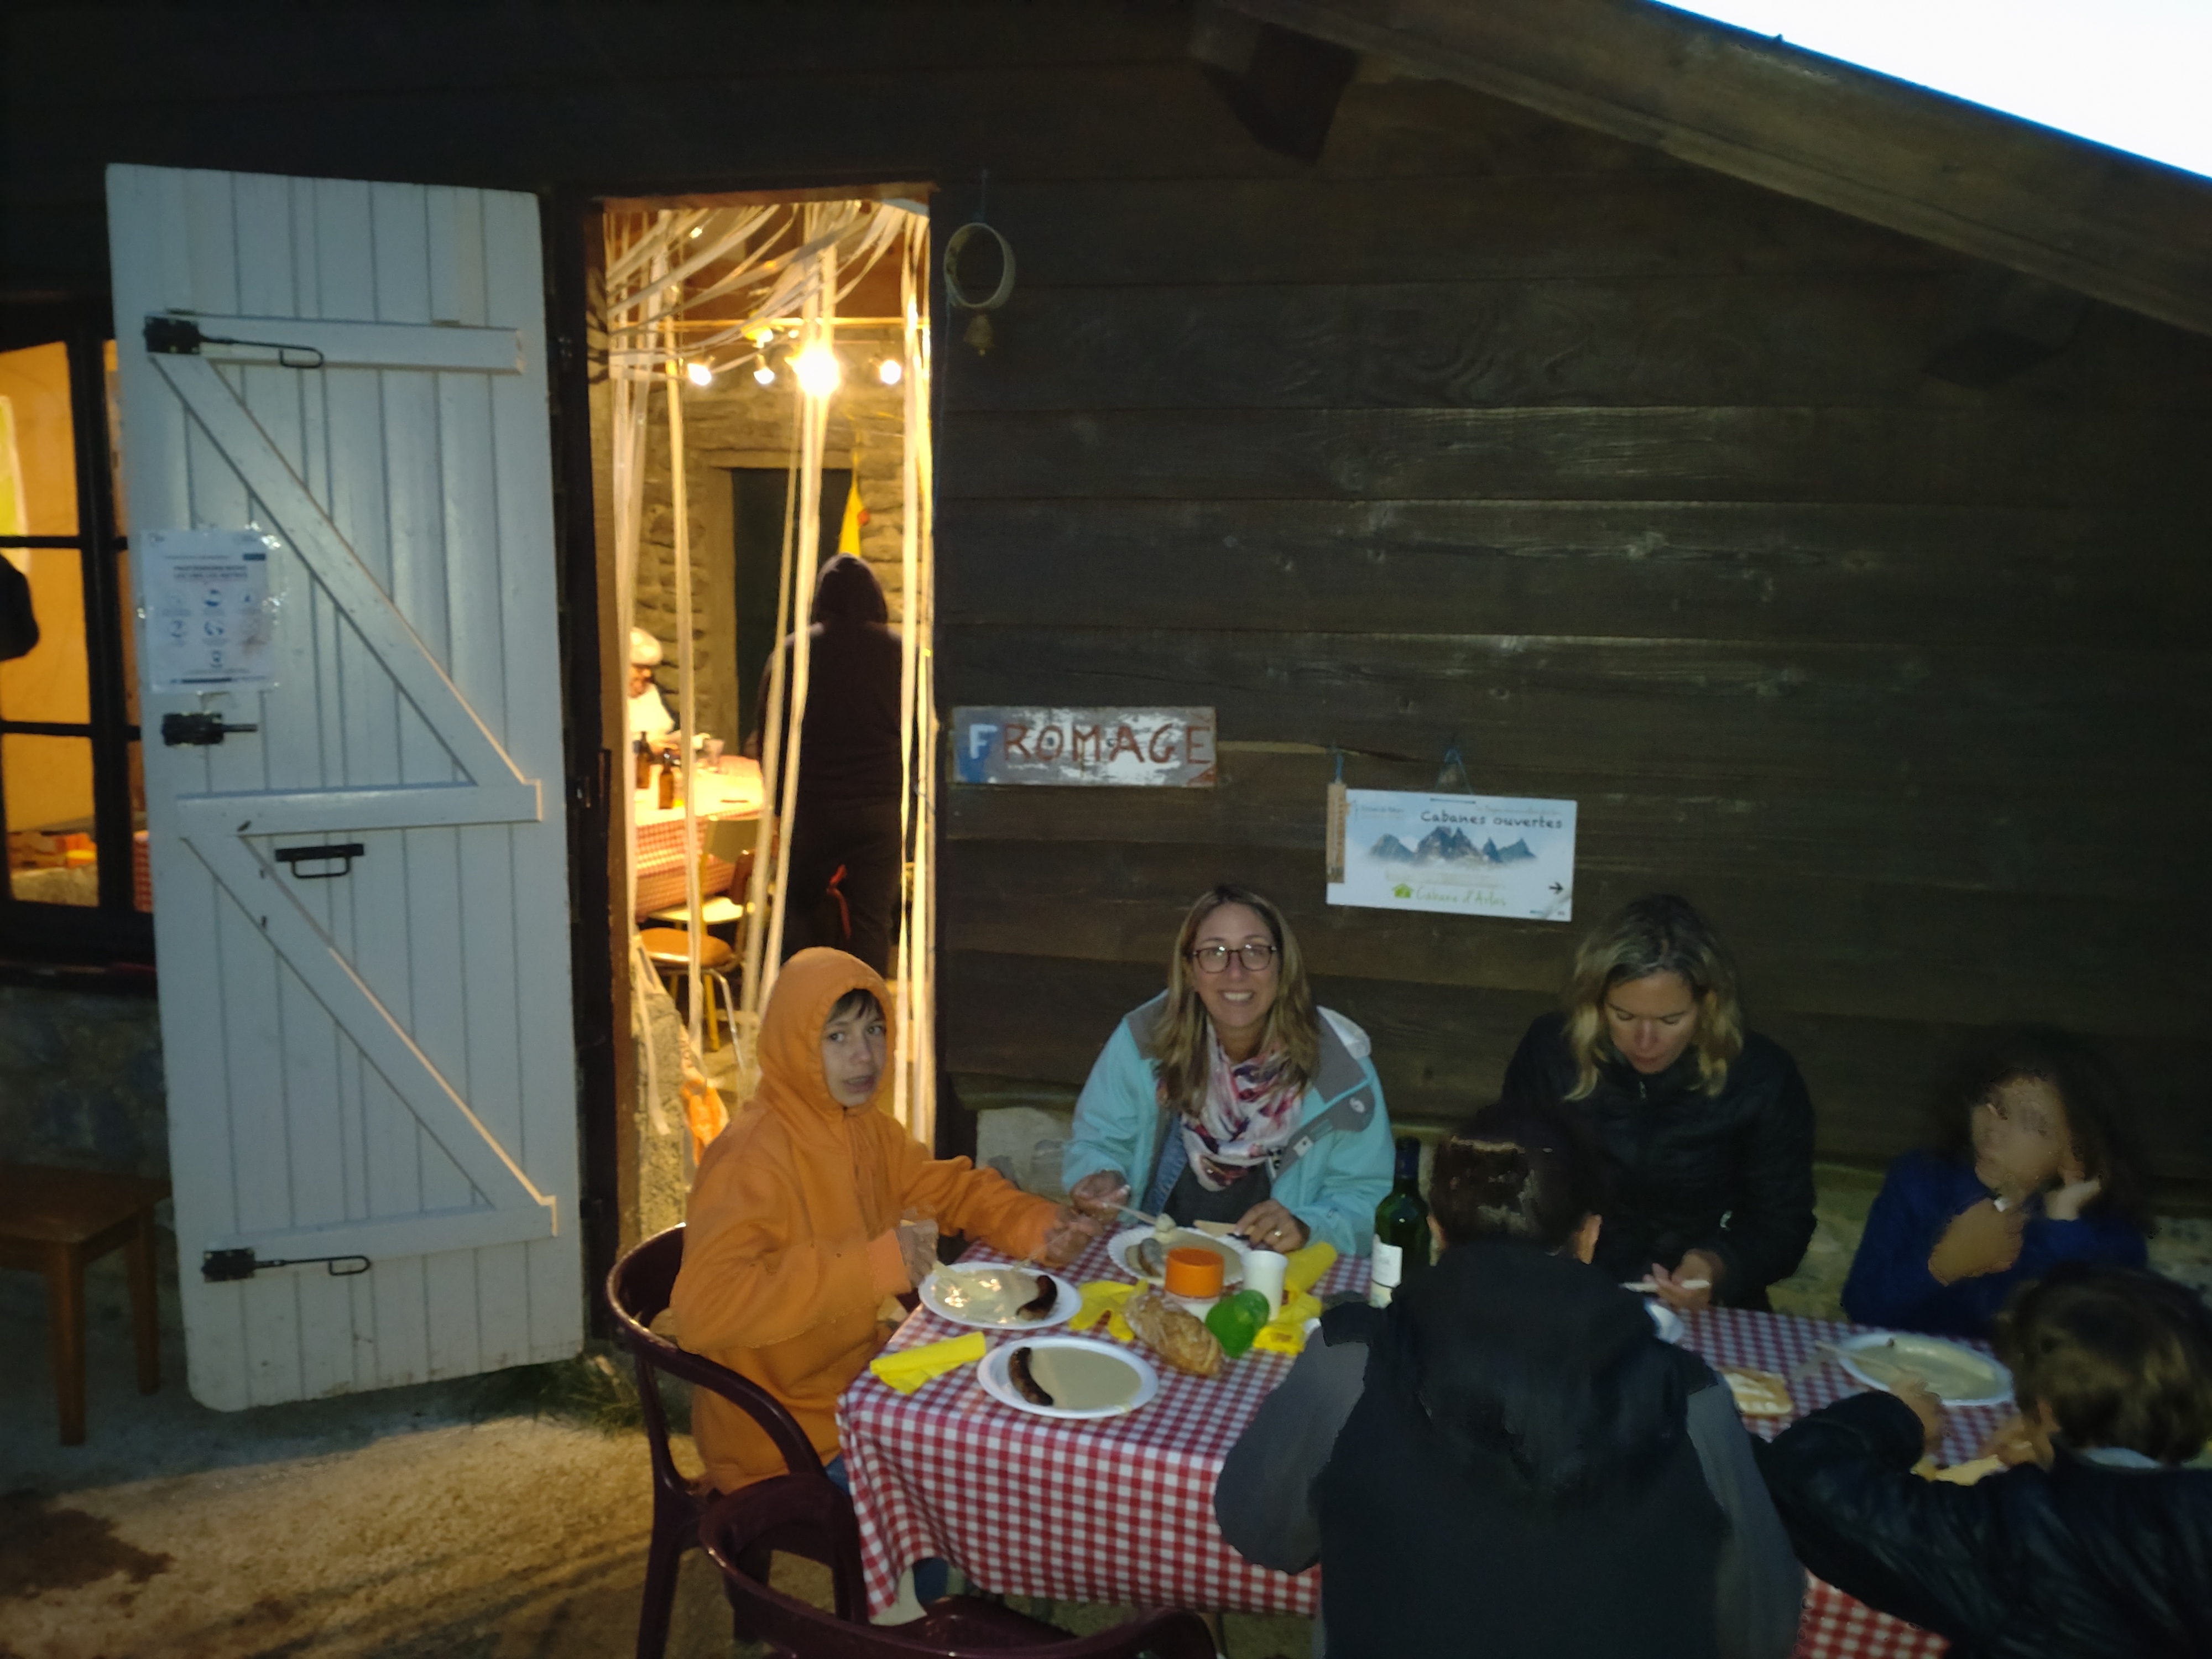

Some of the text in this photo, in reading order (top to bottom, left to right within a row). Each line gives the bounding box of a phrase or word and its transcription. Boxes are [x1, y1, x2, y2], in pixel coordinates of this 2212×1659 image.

[969, 724, 1212, 763] FROMAGE
[1420, 811, 1486, 825] Cabanes
[1493, 813, 1562, 829] ouvertes
